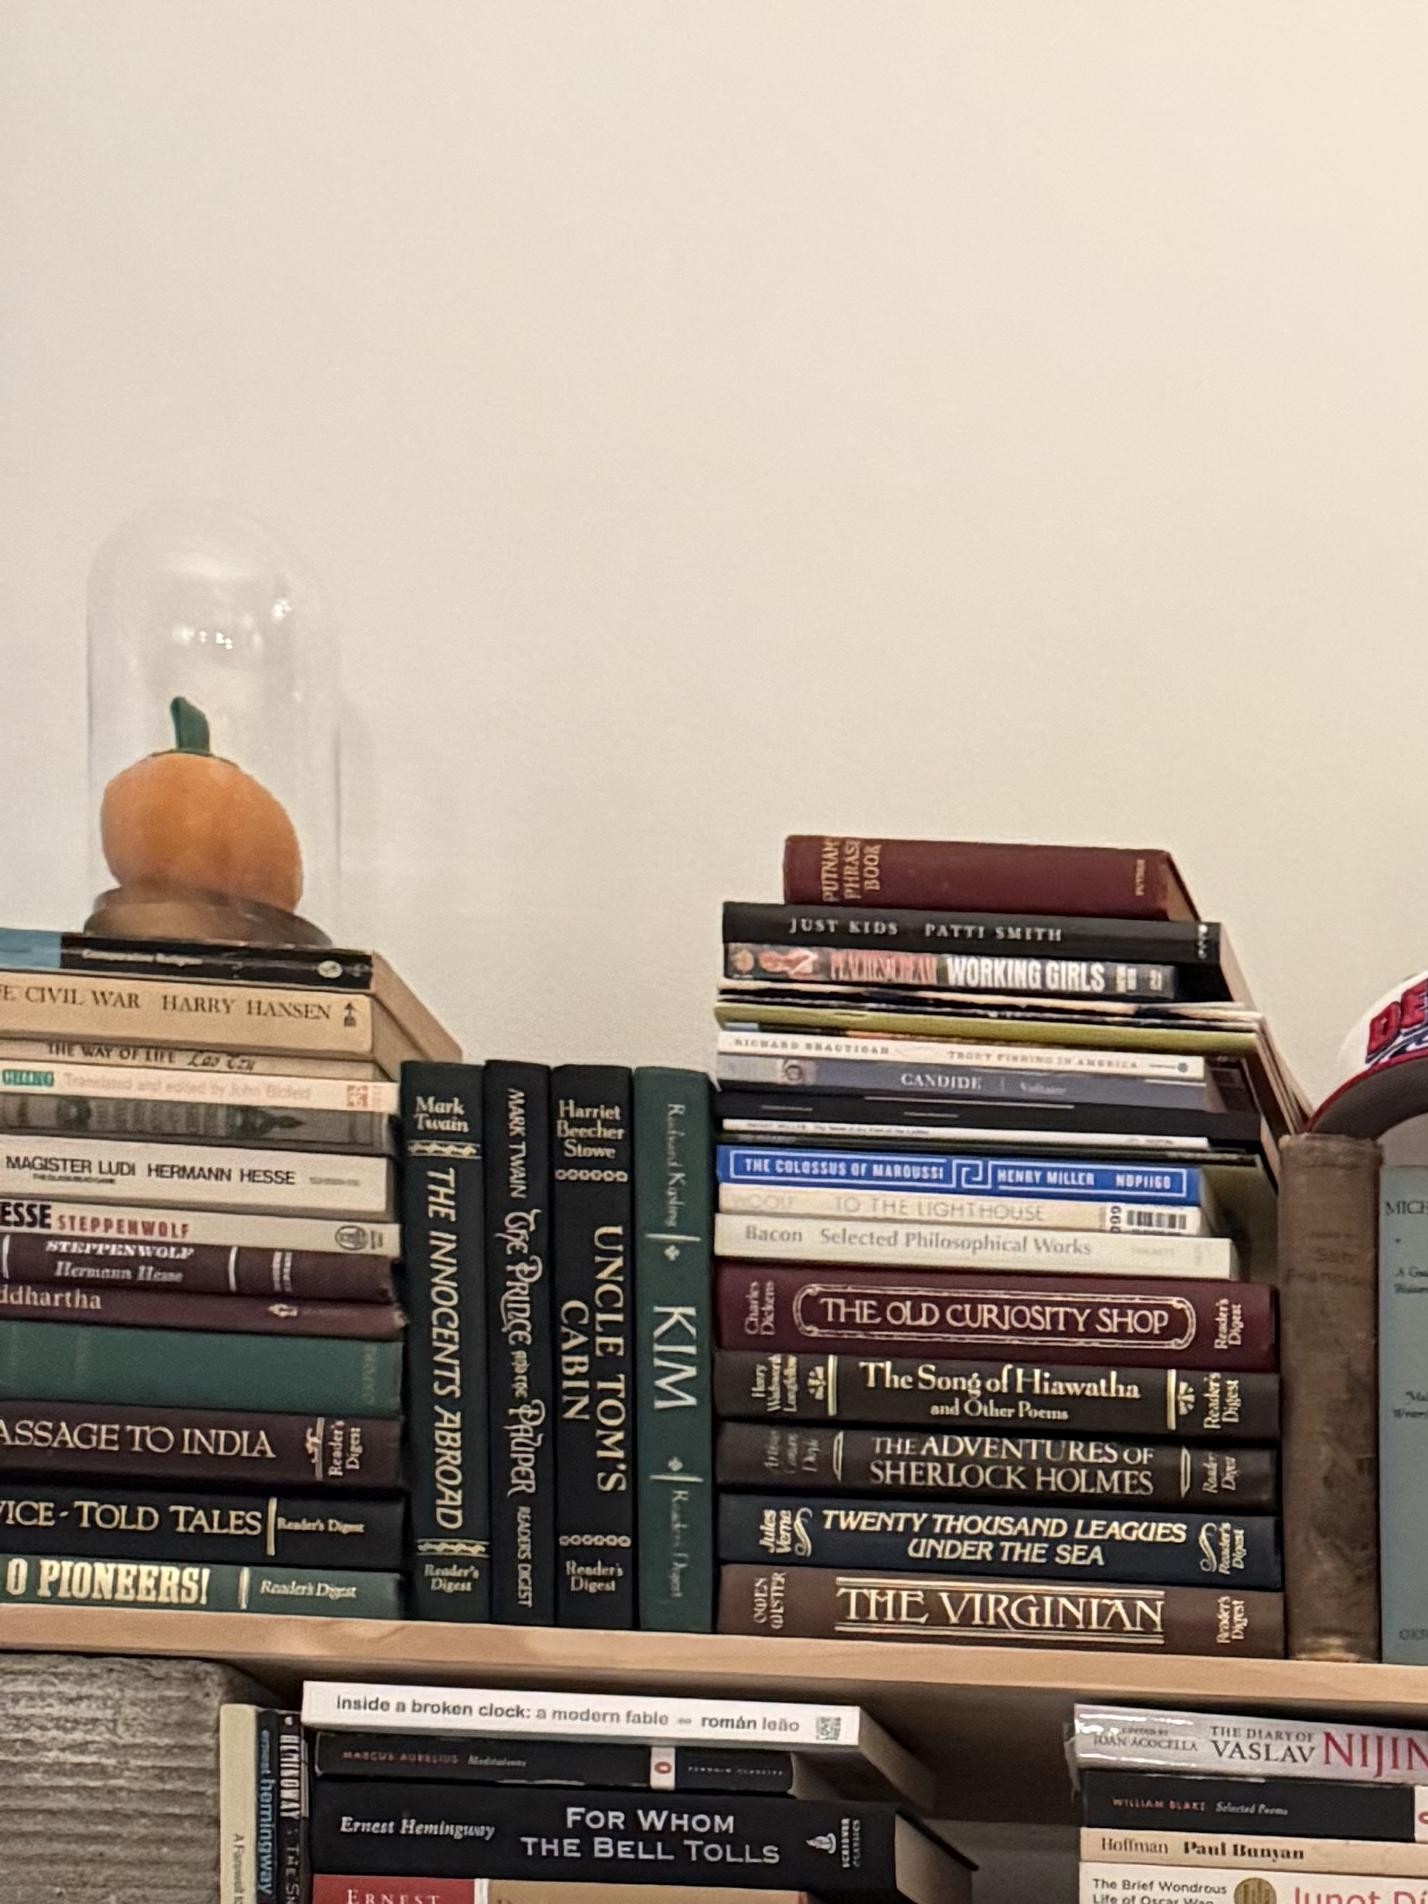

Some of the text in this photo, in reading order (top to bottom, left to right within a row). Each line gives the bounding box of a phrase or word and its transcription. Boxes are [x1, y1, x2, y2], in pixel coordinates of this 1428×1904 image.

[58, 1216, 190, 1238] STEPPENWOLF
[820, 1298, 1168, 1334] THE OLD CURIOSITY SHOP
[652, 1306, 697, 1410] KIM
[566, 1808, 734, 1834] FOR WHOM
[521, 1836, 779, 1864] THE BELL TOLLS
